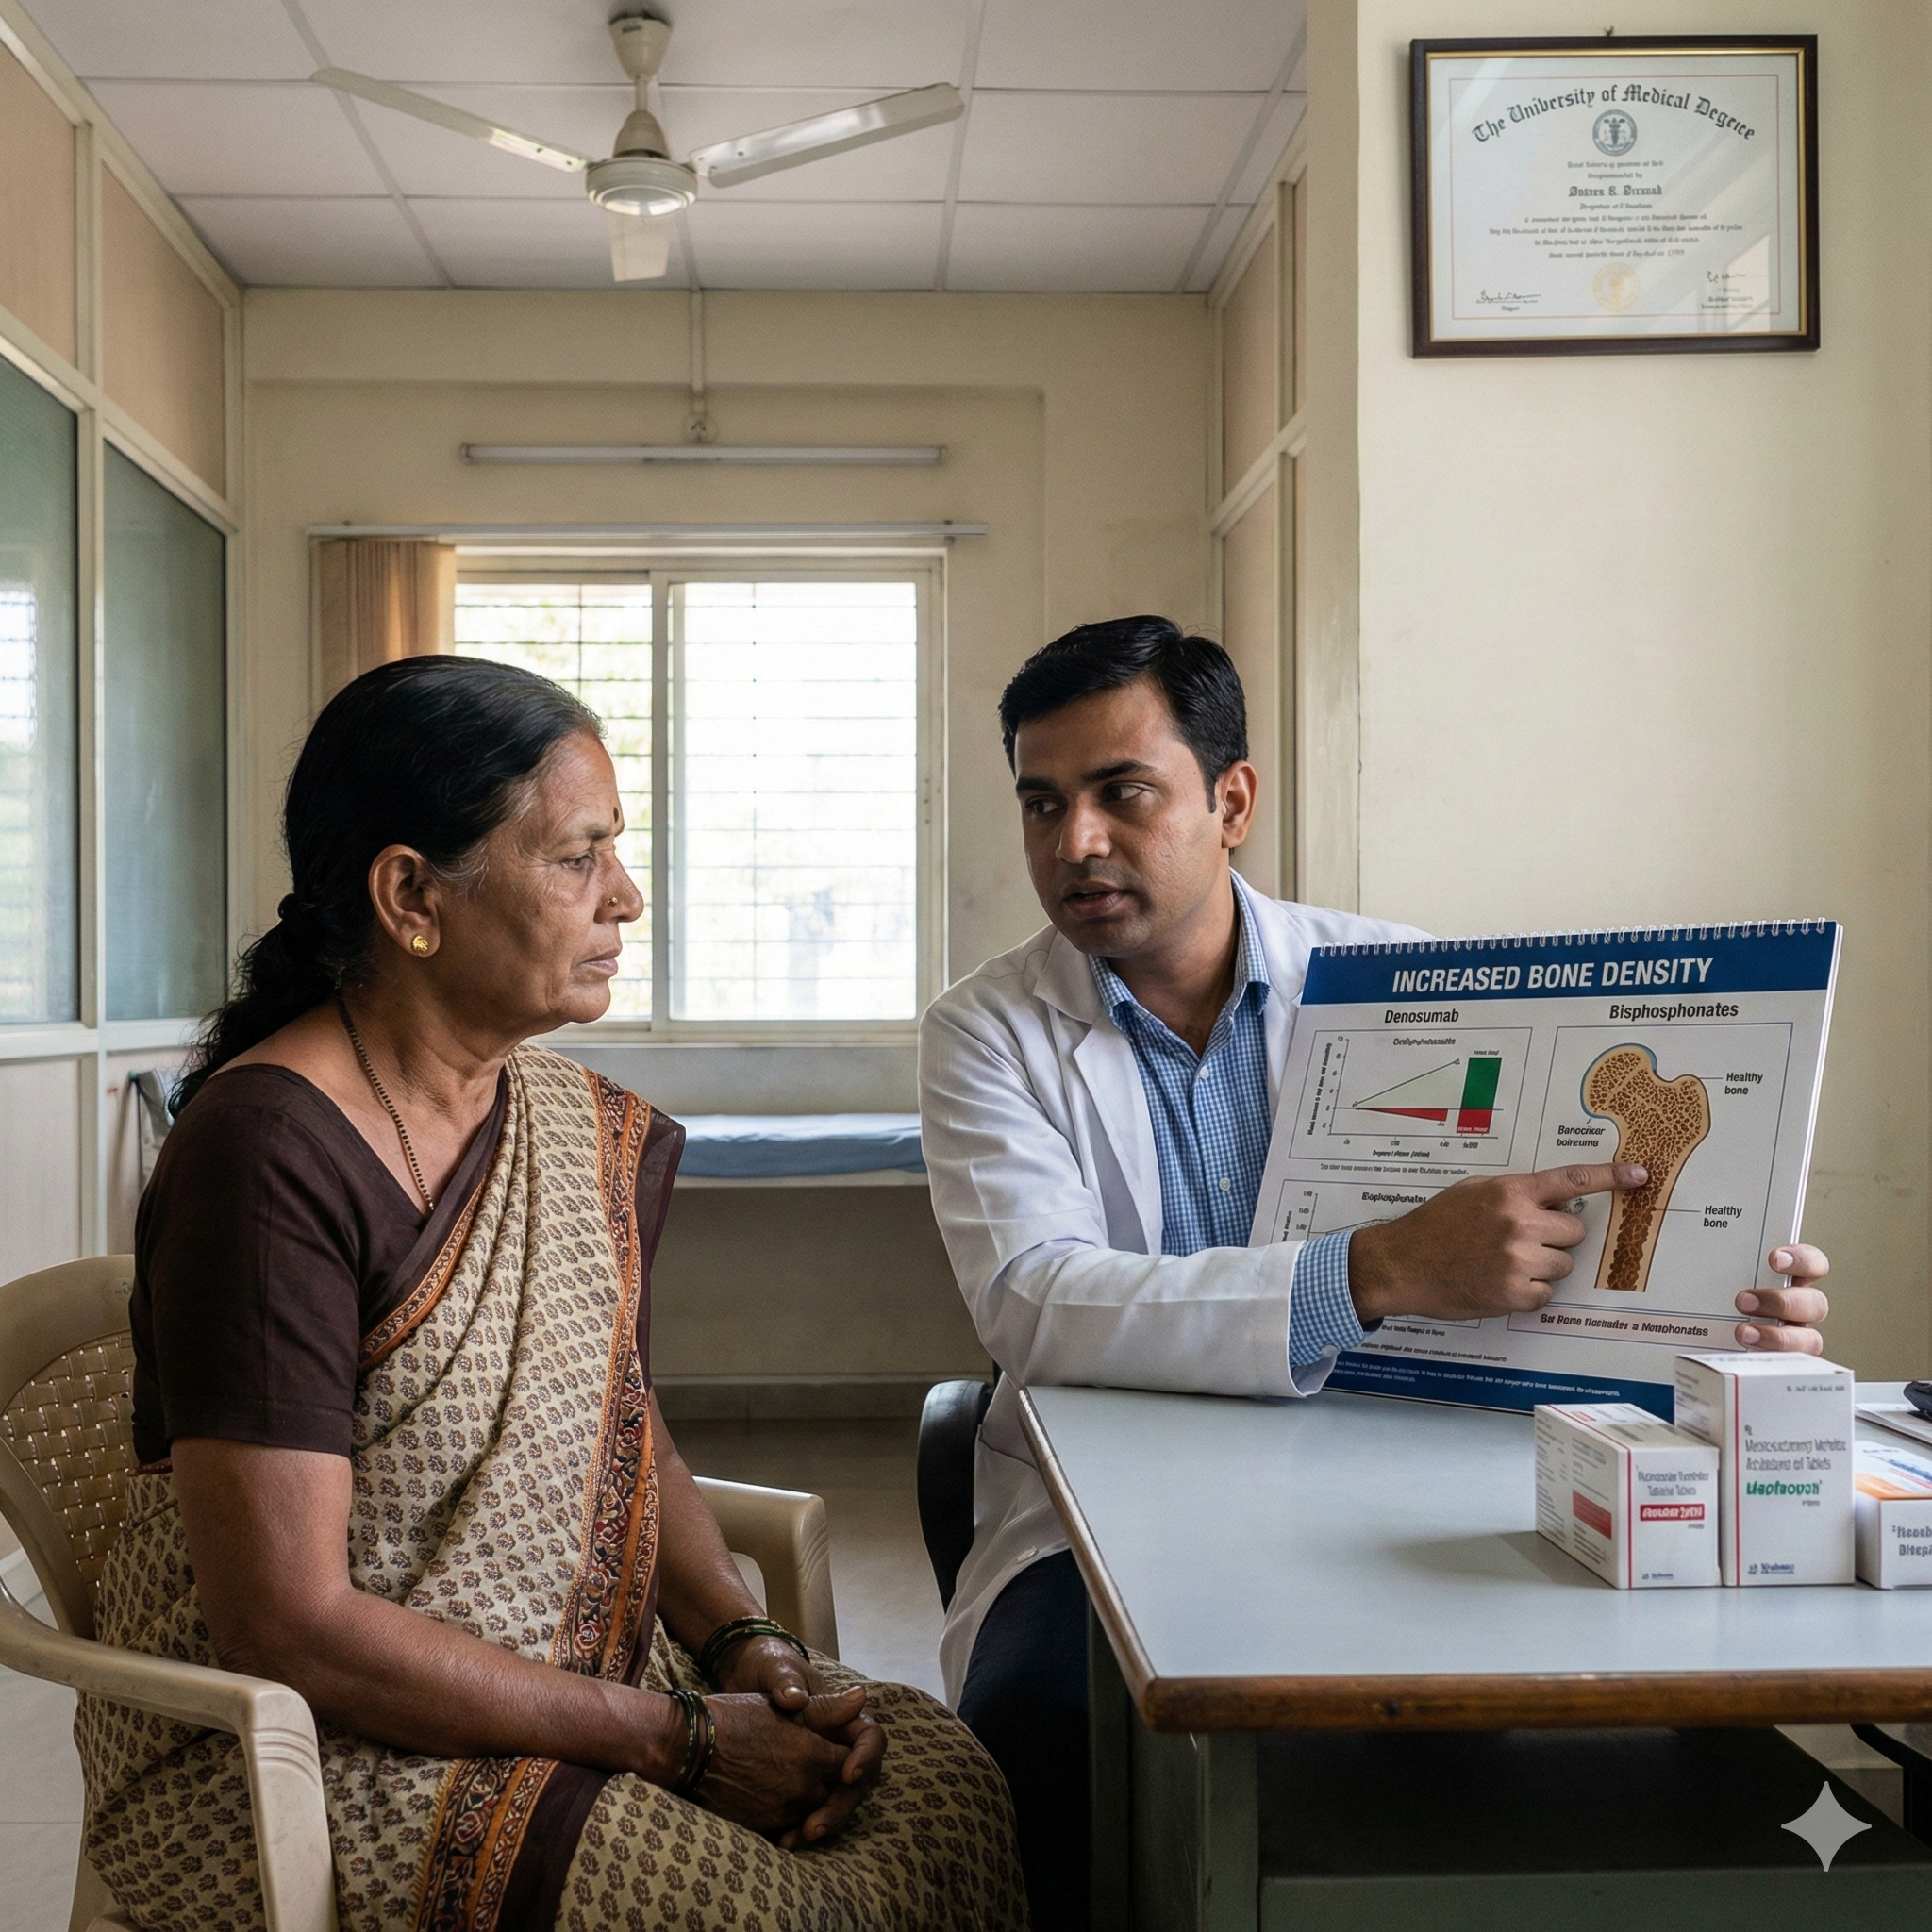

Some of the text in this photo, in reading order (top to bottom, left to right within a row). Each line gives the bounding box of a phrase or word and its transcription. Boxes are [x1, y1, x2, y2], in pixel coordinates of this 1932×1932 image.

[1472, 119, 1506, 142] The
[1507, 88, 1595, 124] University
[1601, 83, 1618, 101] of
[1622, 83, 1691, 110] Medical
[1391, 958, 1714, 993] INCREASED BONE DENSITY
[1384, 1008, 1459, 1024] Denosumab
[1609, 1002, 1739, 1022] Bisphosphonates
[1726, 1072, 1763, 1084] Healthy
[1724, 1085, 1749, 1095] bone
[1705, 1205, 1742, 1218] Healthy
[1703, 1217, 1728, 1228] bone
